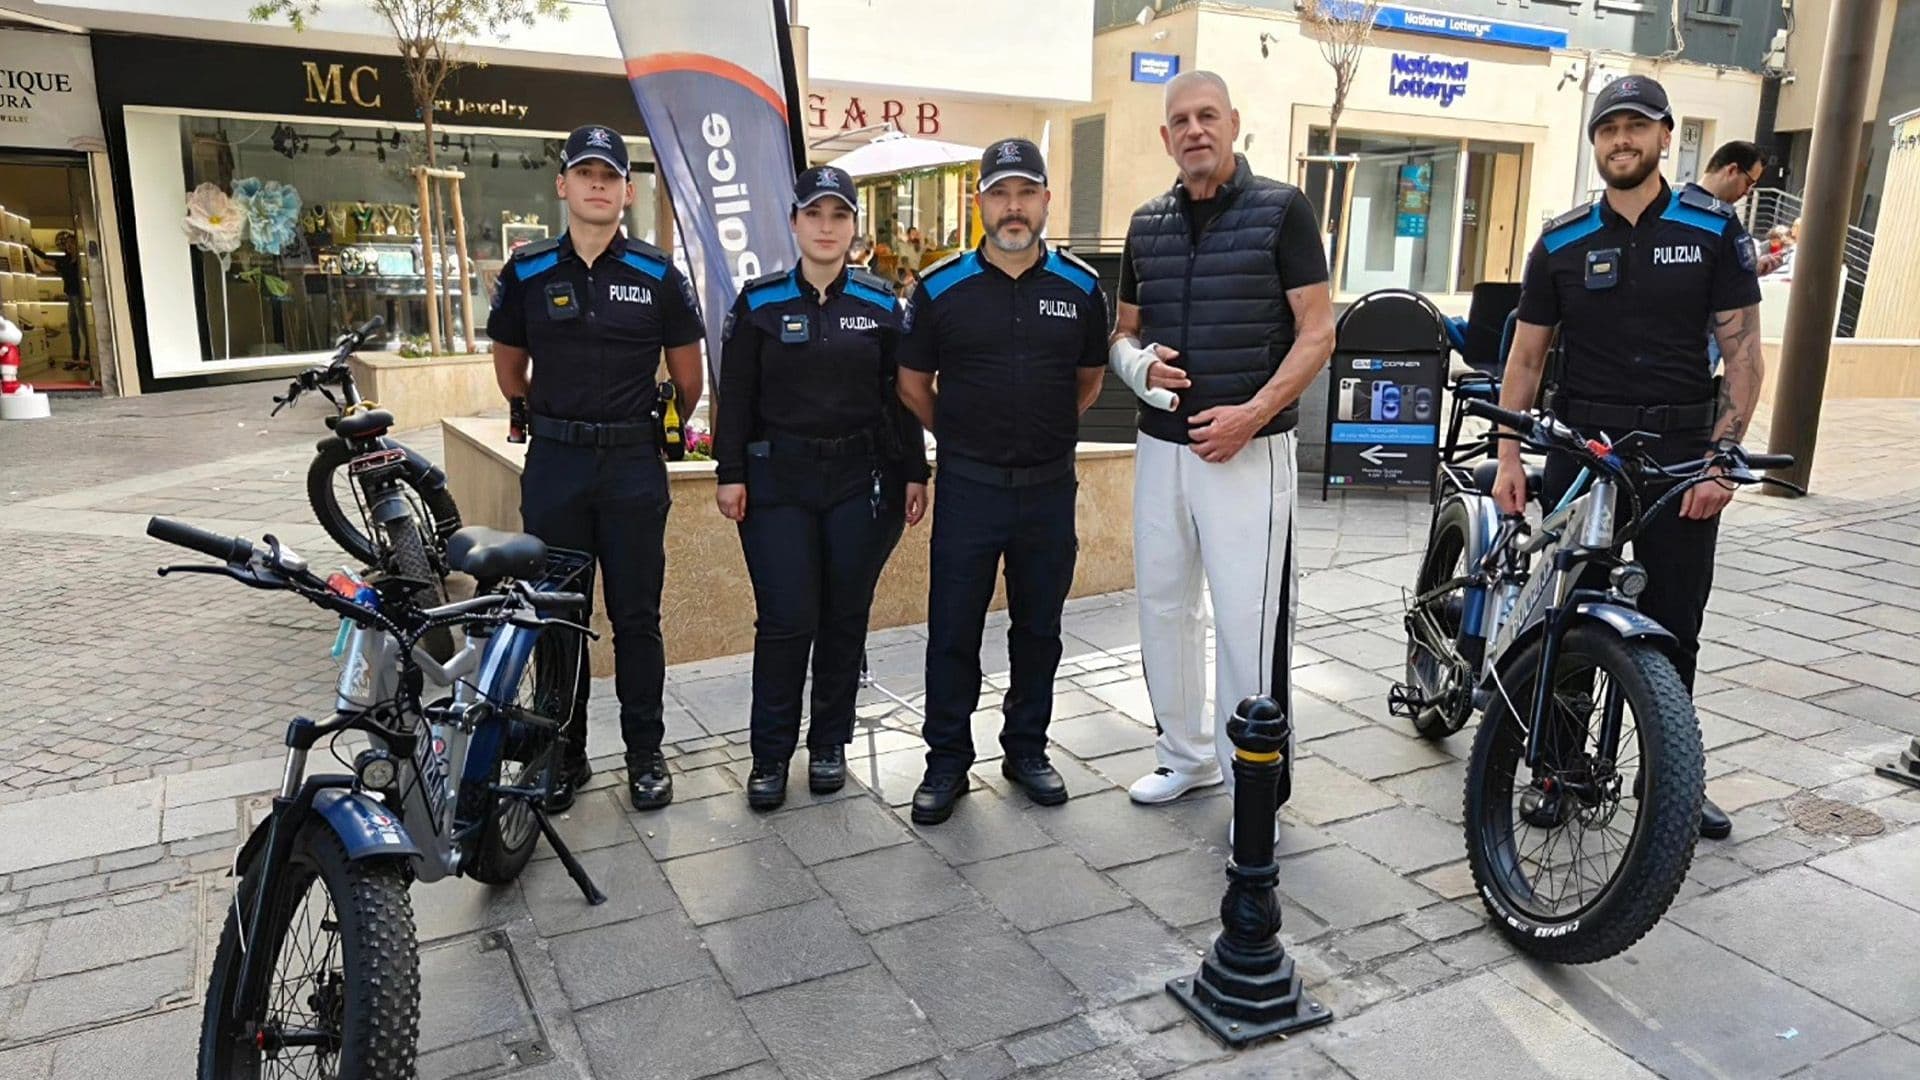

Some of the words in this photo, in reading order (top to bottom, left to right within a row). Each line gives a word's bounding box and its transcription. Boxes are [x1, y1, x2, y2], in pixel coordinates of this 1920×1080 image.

[1404, 12, 1446, 28] National
[1449, 18, 1484, 37] Lottery
[1391, 53, 1469, 81] National
[302, 61, 381, 108] MC
[1389, 75, 1454, 107] Lottery
[454, 97, 528, 120] Jewelry
[702, 113, 762, 295] Police
[1654, 245, 1702, 265] PULIZIJA
[609, 285, 653, 305] PULIZIJA
[1039, 299, 1077, 319] PULIZIJA
